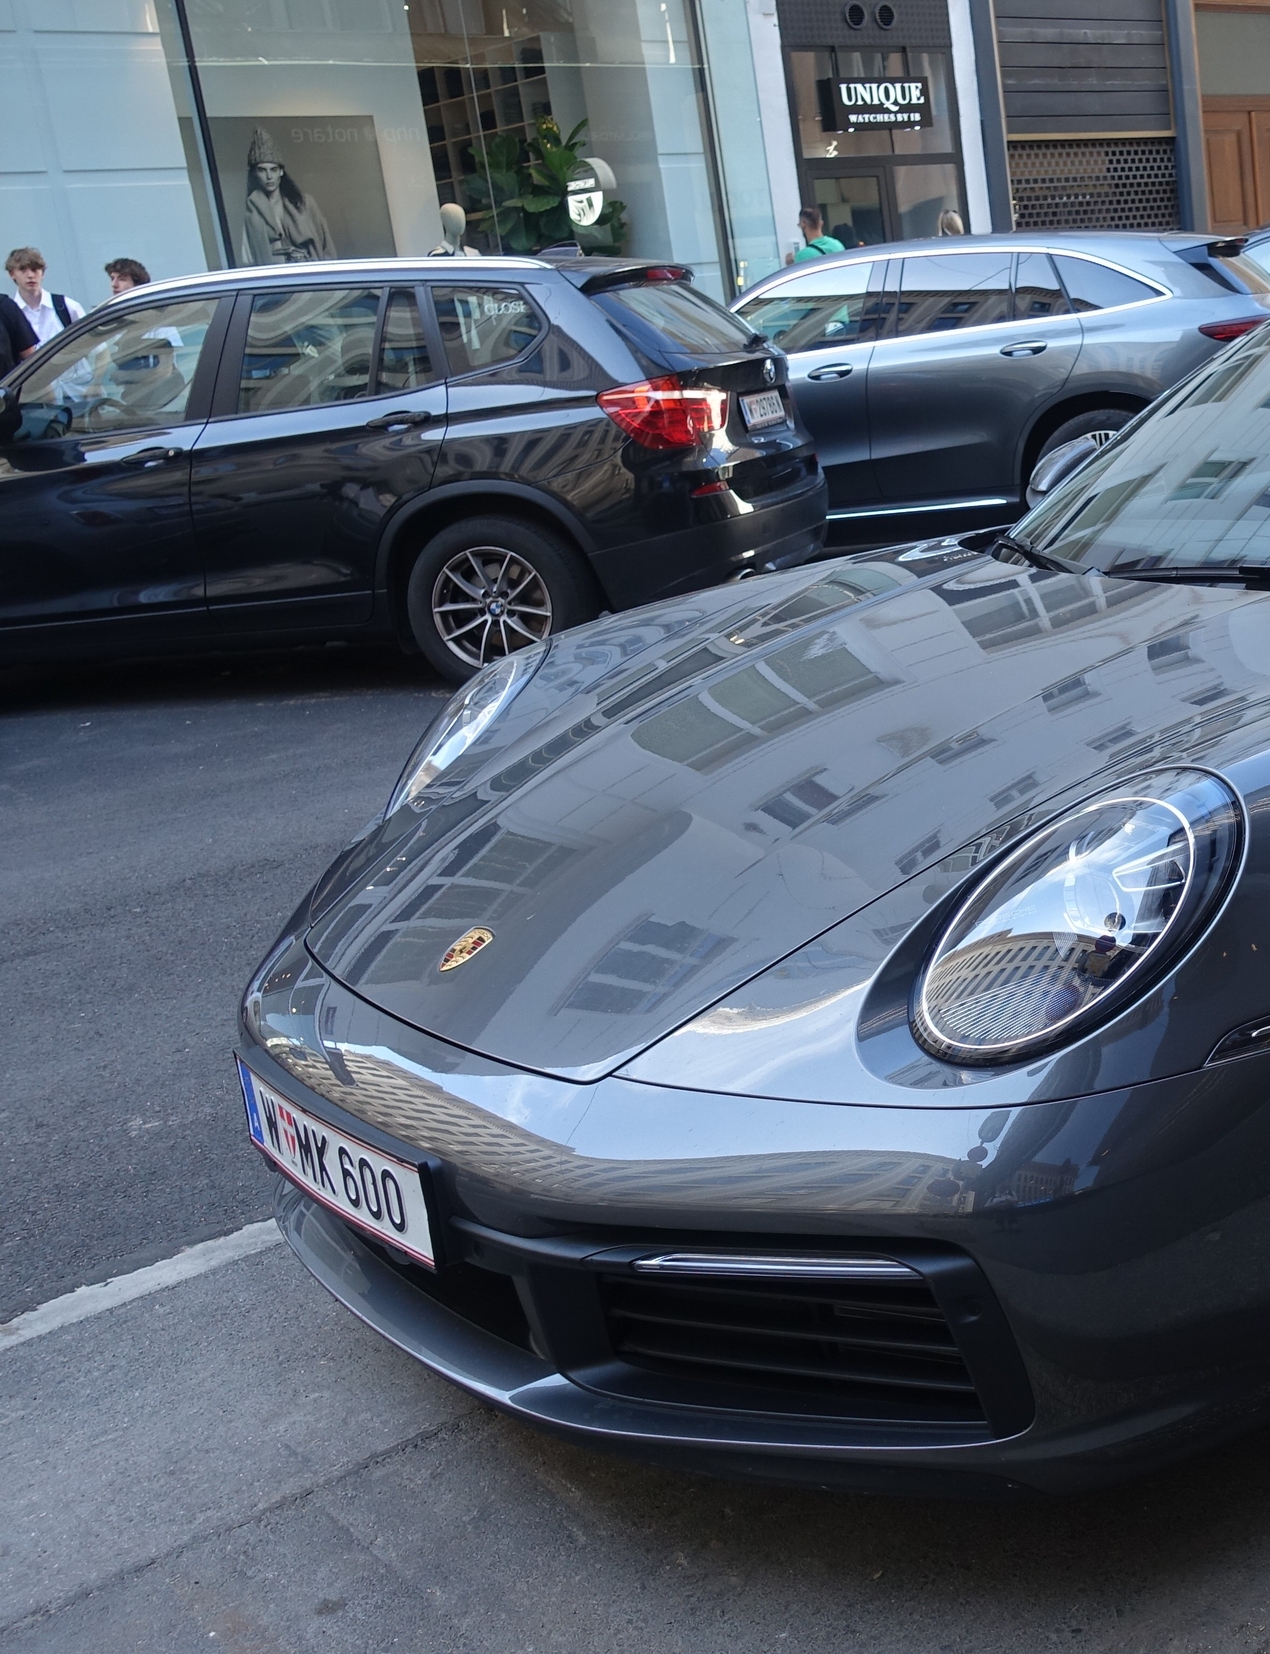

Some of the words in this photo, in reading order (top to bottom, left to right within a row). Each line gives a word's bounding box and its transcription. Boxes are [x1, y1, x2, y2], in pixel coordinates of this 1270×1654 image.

[839, 82, 925, 111] UNIQUE
[848, 114, 895, 123] WATCHES
[896, 114, 909, 122] BY
[259, 1087, 284, 1155] W
[292, 1114, 338, 1196] MK
[337, 1144, 408, 1234] 600
